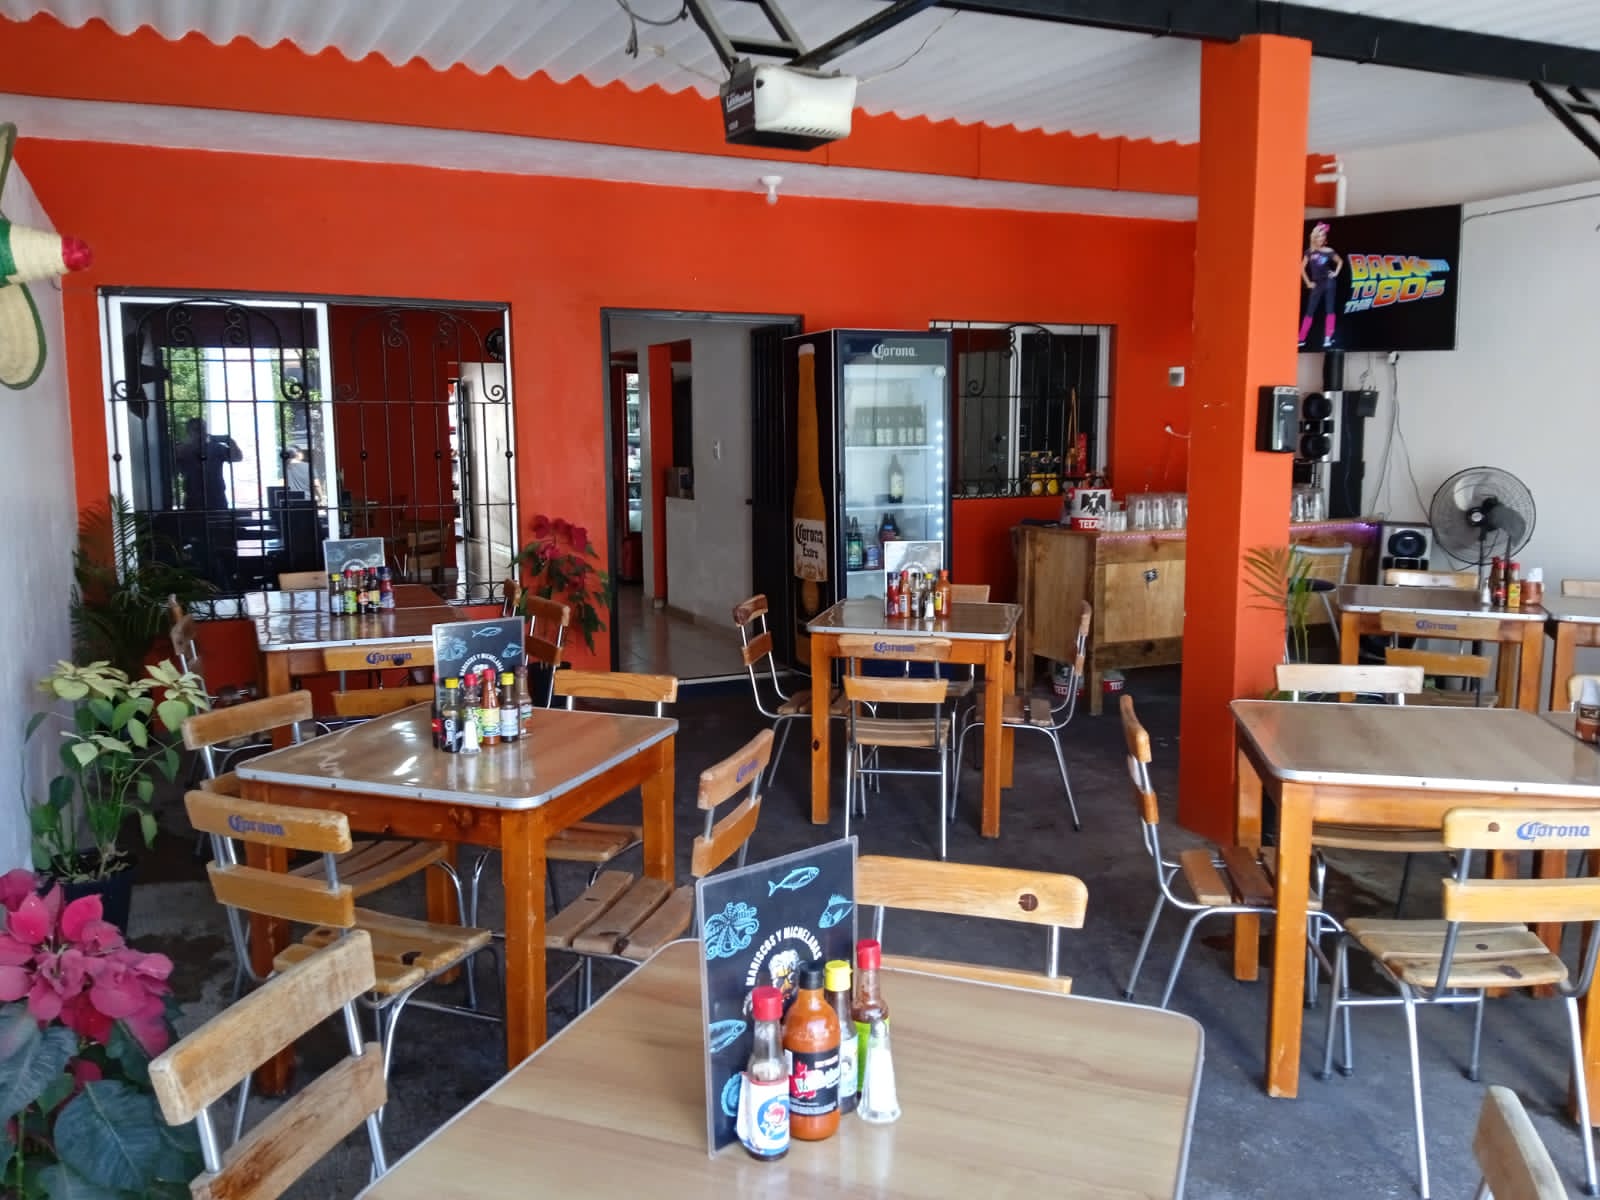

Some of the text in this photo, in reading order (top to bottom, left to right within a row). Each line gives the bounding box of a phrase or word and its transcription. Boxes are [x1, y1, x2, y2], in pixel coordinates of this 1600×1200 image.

[1348, 254, 1429, 280] BACK
[1351, 279, 1377, 299] TO
[1343, 297, 1373, 313] THE
[871, 342, 915, 360] Corona
[795, 522, 824, 544] Corona
[802, 543, 818, 559] Extra
[873, 641, 916, 653] Corona
[228, 814, 285, 836] Corona
[1516, 821, 1590, 841] Corona
[745, 925, 823, 986] MARISCOS Y MICHELADAS
